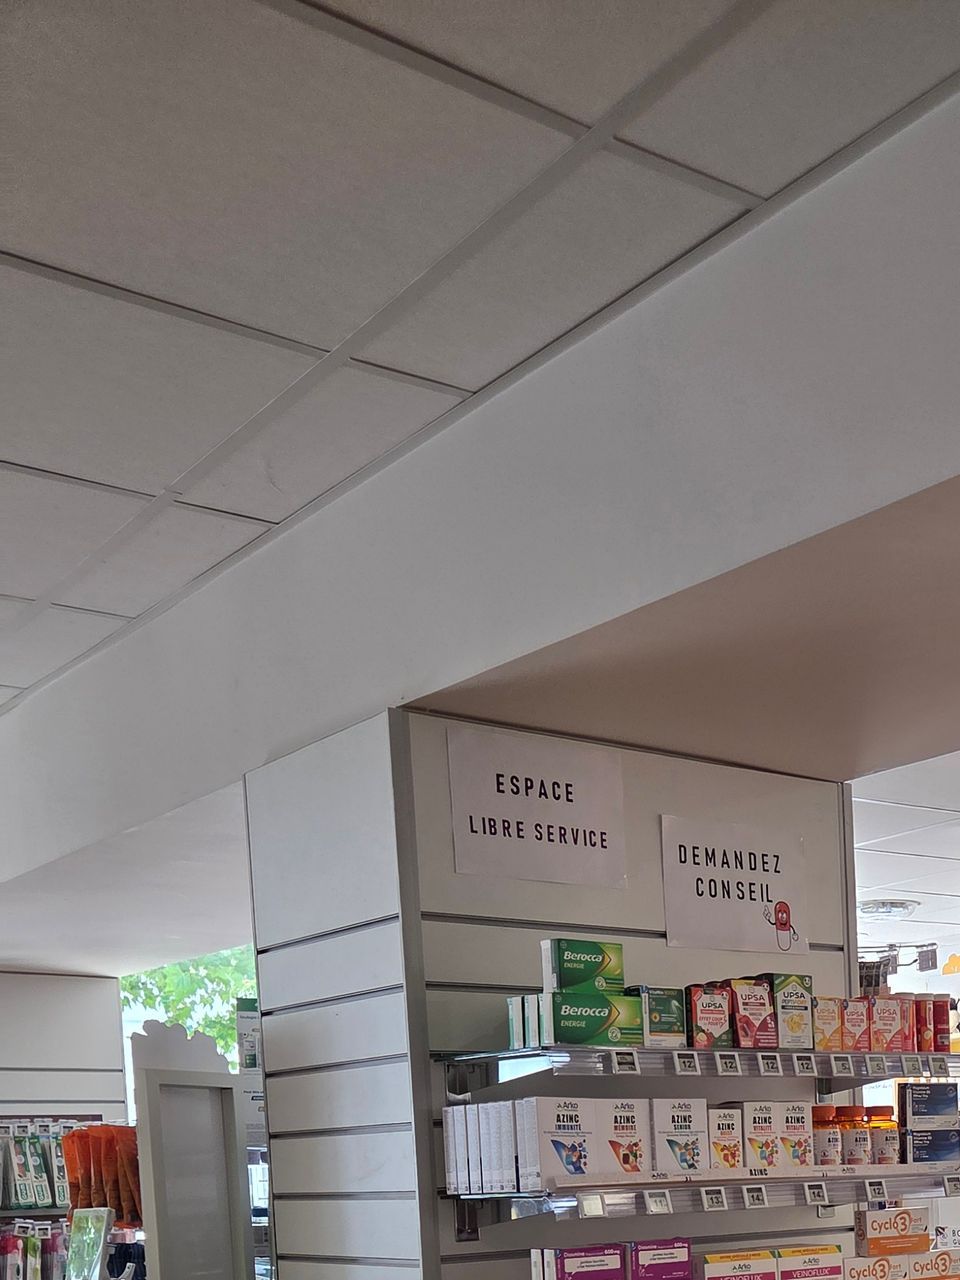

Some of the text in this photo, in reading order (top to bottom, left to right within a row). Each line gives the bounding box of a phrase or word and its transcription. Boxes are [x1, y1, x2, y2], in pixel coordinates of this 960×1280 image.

[496, 773, 575, 803] ESPACE
[468, 815, 609, 850] LIBRE SERVICE
[678, 843, 782, 875] DEMANDEZ
[695, 876, 774, 904] CONSEIL
[563, 950, 603, 963] Berocca
[740, 993, 765, 1002] UPSA
[560, 1004, 609, 1017] Berocca
[701, 1002, 723, 1010] UPSA
[556, 1115, 579, 1124] AZINC
[614, 1115, 635, 1124] AZINC
[671, 1115, 692, 1124] AZINC
[752, 1116, 772, 1125] AZINC
[785, 1116, 805, 1125] AZINC
[871, 1218, 899, 1233] Cyclo
[849, 1265, 877, 1280] Cyclo
[913, 1260, 939, 1273] Cyclo
[792, 1269, 829, 1278] VEINOFLUX
